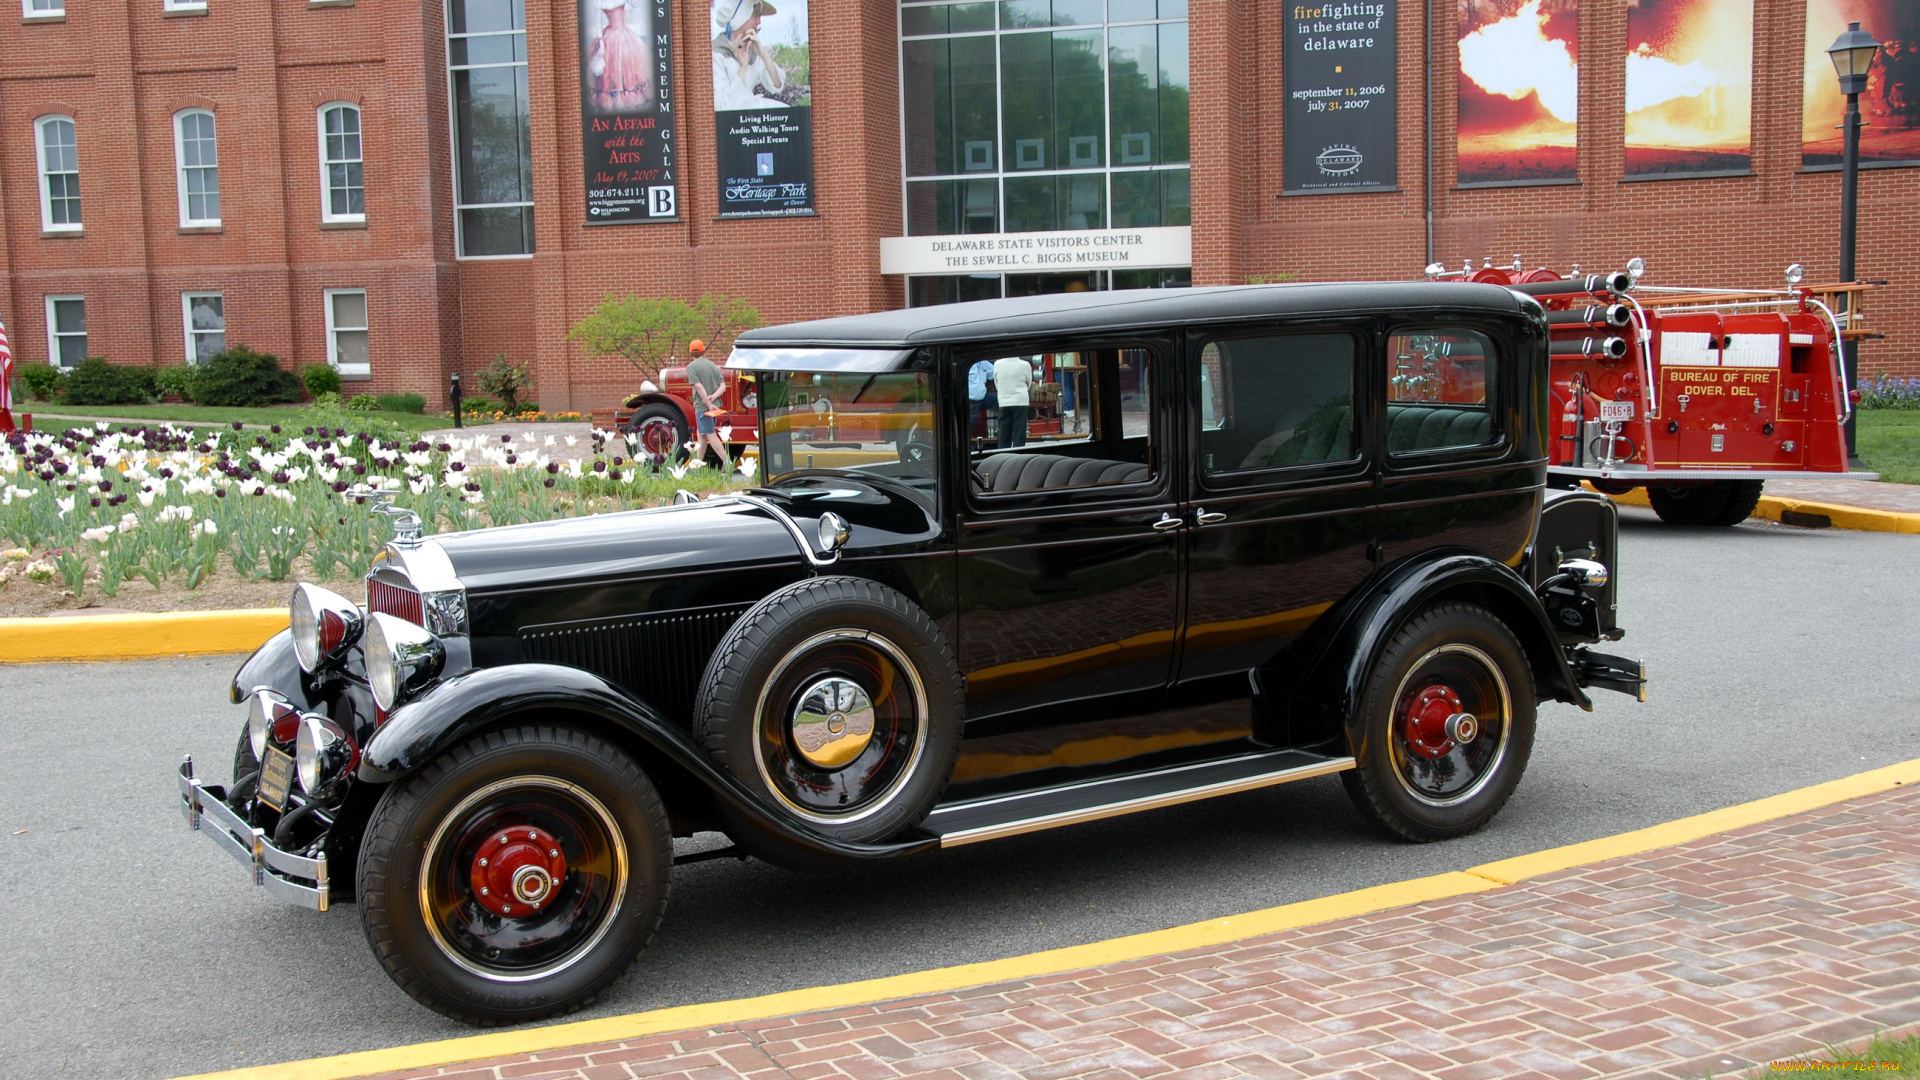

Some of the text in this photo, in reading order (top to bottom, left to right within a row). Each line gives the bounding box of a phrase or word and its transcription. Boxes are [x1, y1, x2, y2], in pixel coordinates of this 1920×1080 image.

[1294, 3, 1384, 20] firefighting
[1298, 18, 1380, 34] in the state of
[1304, 37, 1374, 51] delaware
[657, 34, 670, 113] MUSEUM
[1293, 84, 1385, 100] september 11, 2006
[1307, 100, 1370, 113] july 31, 2007
[740, 114, 789, 124] Living History
[729, 124, 799, 135] Audio Walking Tours
[604, 130, 645, 148] with the
[741, 136, 789, 147] Special Events
[661, 129, 672, 180] GALA
[593, 171, 614, 190] May
[631, 169, 659, 180] 2007
[589, 187, 645, 198] 302.674.2111
[725, 183, 807, 203] Heritage Park
[932, 235, 1143, 252] DELAWARE STATE VISITORS CENTER
[945, 251, 1129, 267] THE SEWELL C. BIGGS MUSEUM
[1670, 371, 1770, 383] BUREAU OF FIRE
[1684, 385, 1757, 397] DOVER, DEL.
